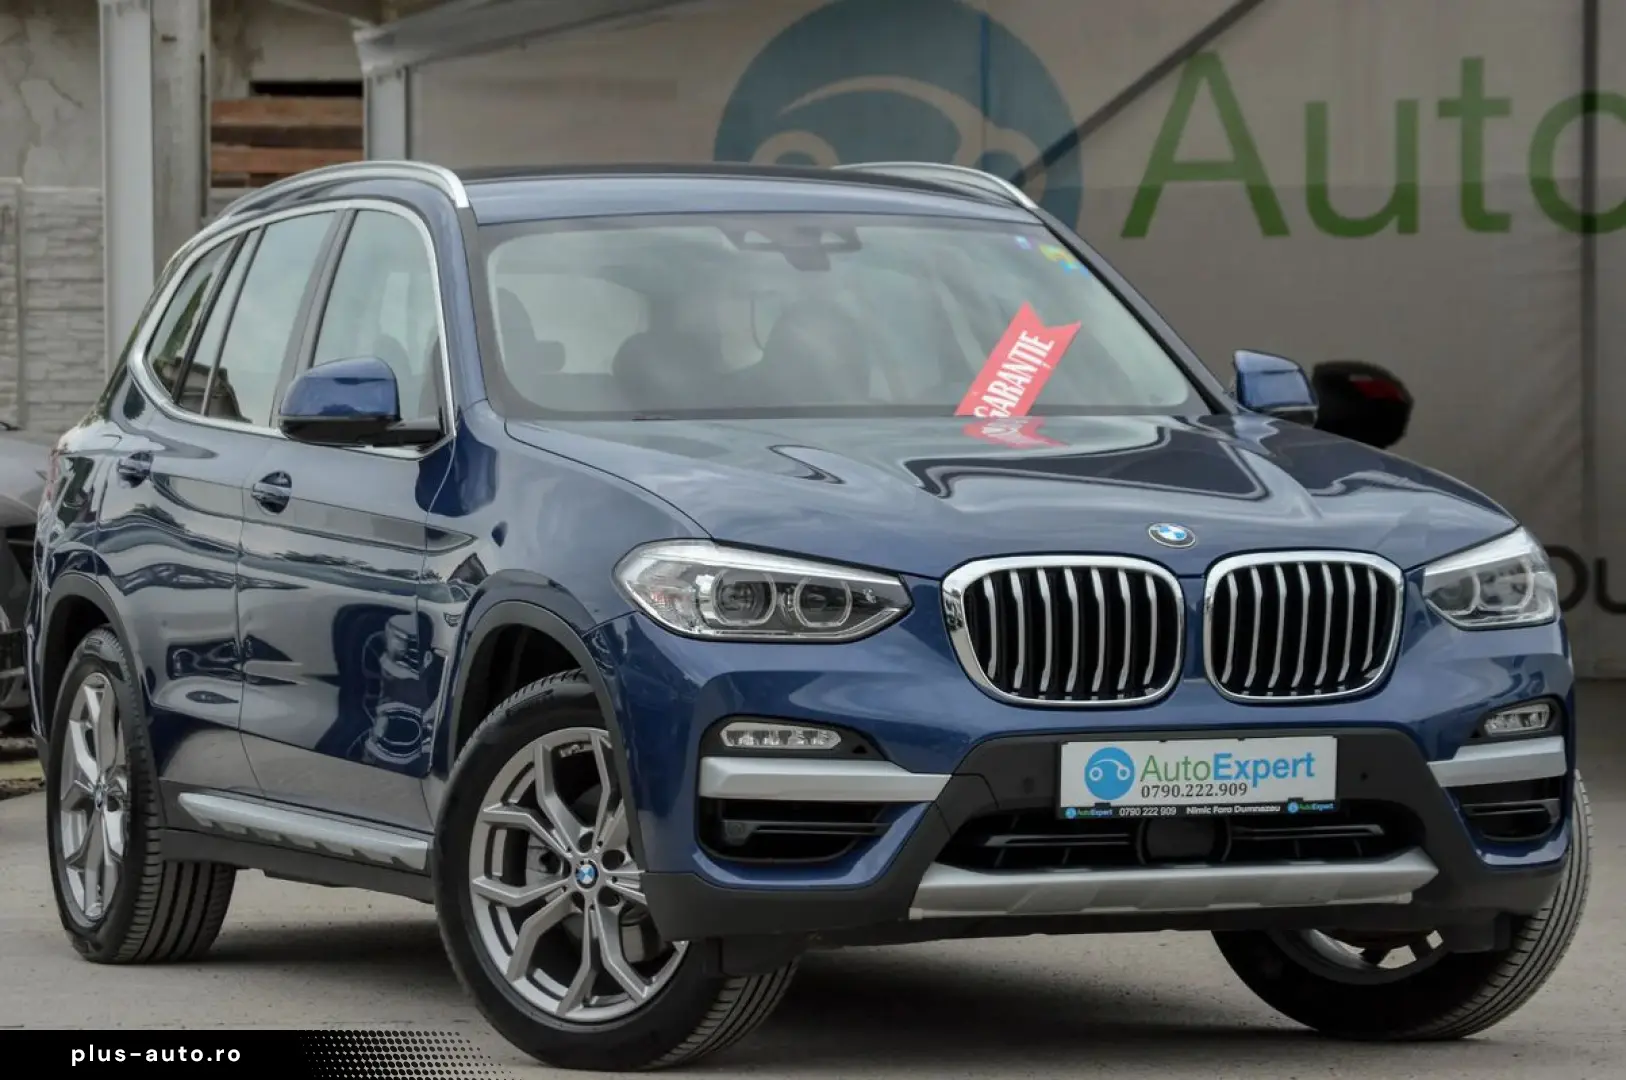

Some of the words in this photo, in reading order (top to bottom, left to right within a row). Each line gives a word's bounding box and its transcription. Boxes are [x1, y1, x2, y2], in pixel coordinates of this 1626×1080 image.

[1120, 50, 1626, 239] Auto
[1140, 751, 1316, 788] AutoExpert
[1141, 782, 1248, 799] 0790.222.909
[1119, 806, 1141, 817] 0790
[1142, 806, 1159, 816] 222
[1160, 806, 1177, 816] 909
